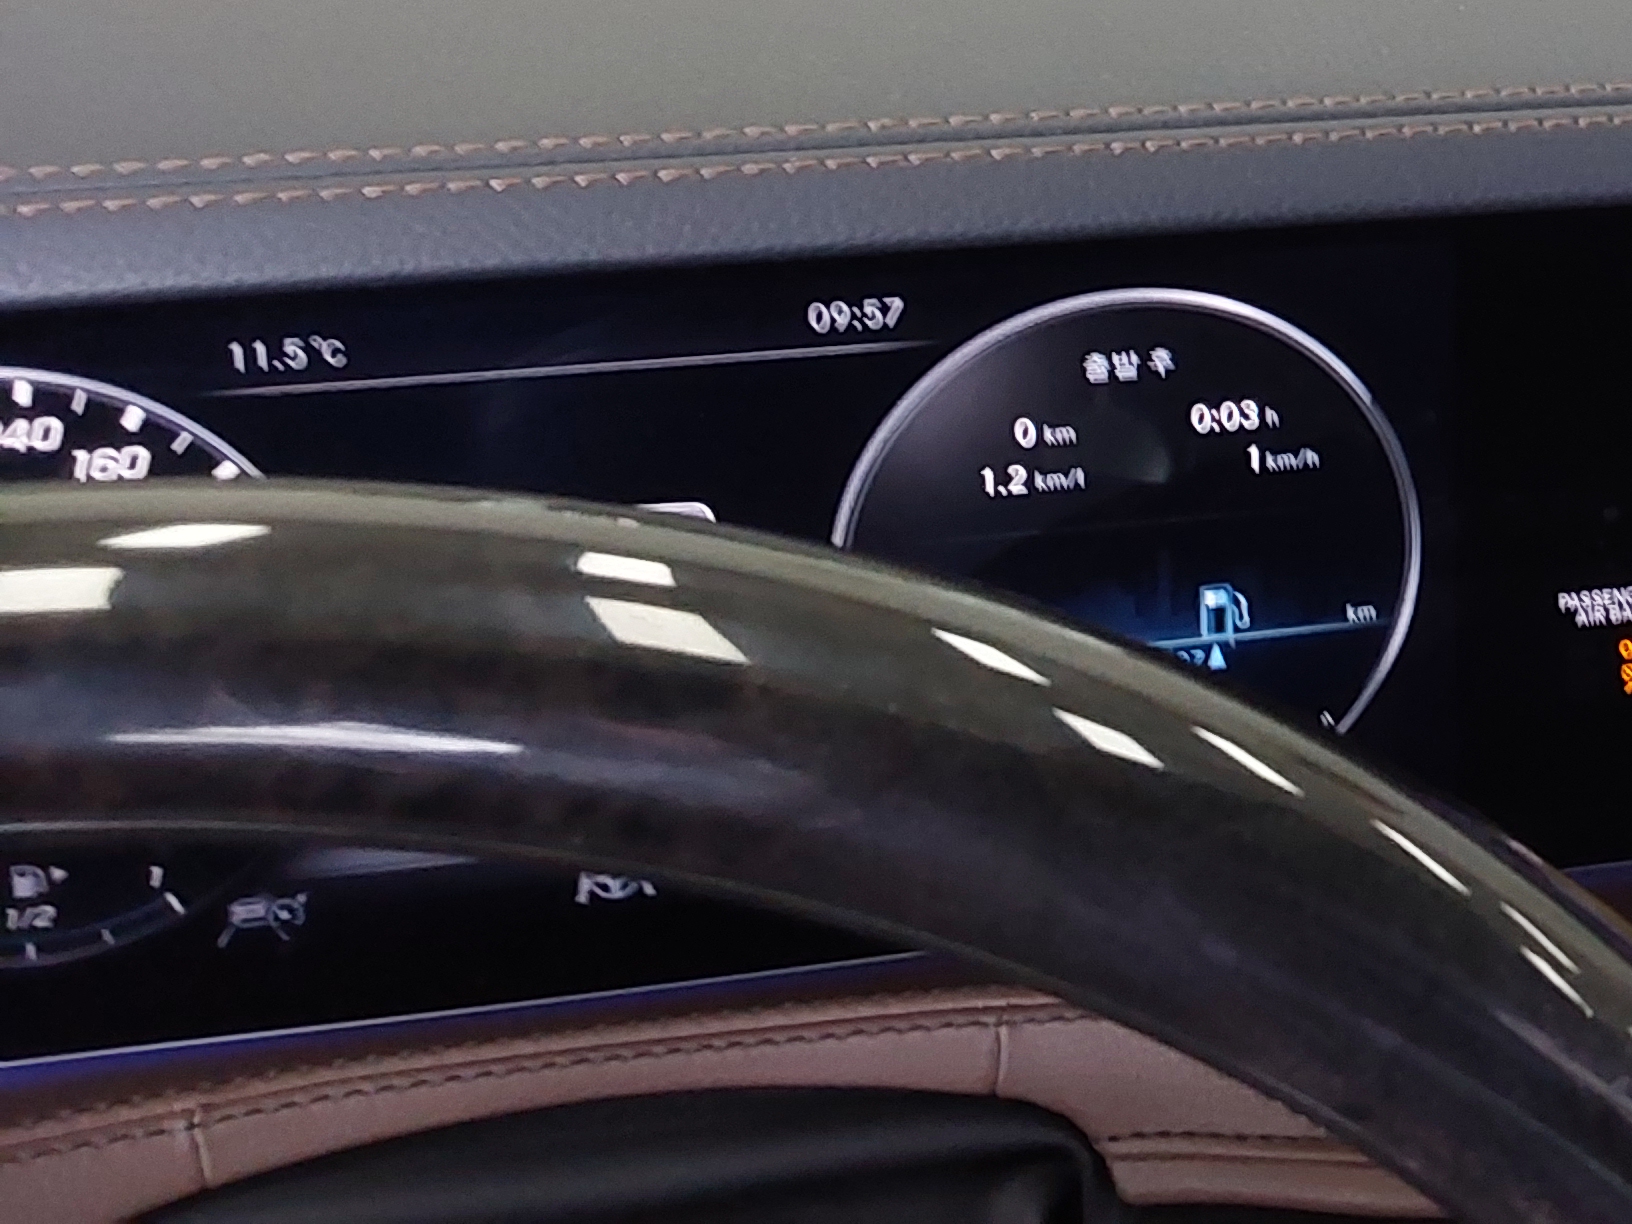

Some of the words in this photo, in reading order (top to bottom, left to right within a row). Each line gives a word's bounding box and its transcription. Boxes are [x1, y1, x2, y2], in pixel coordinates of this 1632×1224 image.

[807, 296, 905, 334] 09:57
[1082, 349, 1141, 384] 출발
[1147, 346, 1176, 379] 후
[1013, 416, 1038, 450] 0
[1042, 422, 1078, 447] km
[1190, 399, 1260, 435] 0:03
[71, 444, 152, 483] 160
[1246, 443, 1261, 475] 1
[1264, 446, 1321, 473] km/h
[979, 463, 1030, 498] 1.2
[1345, 602, 1377, 624] km
[1575, 602, 1607, 628] AIR
[5, 904, 58, 930] 1/2
